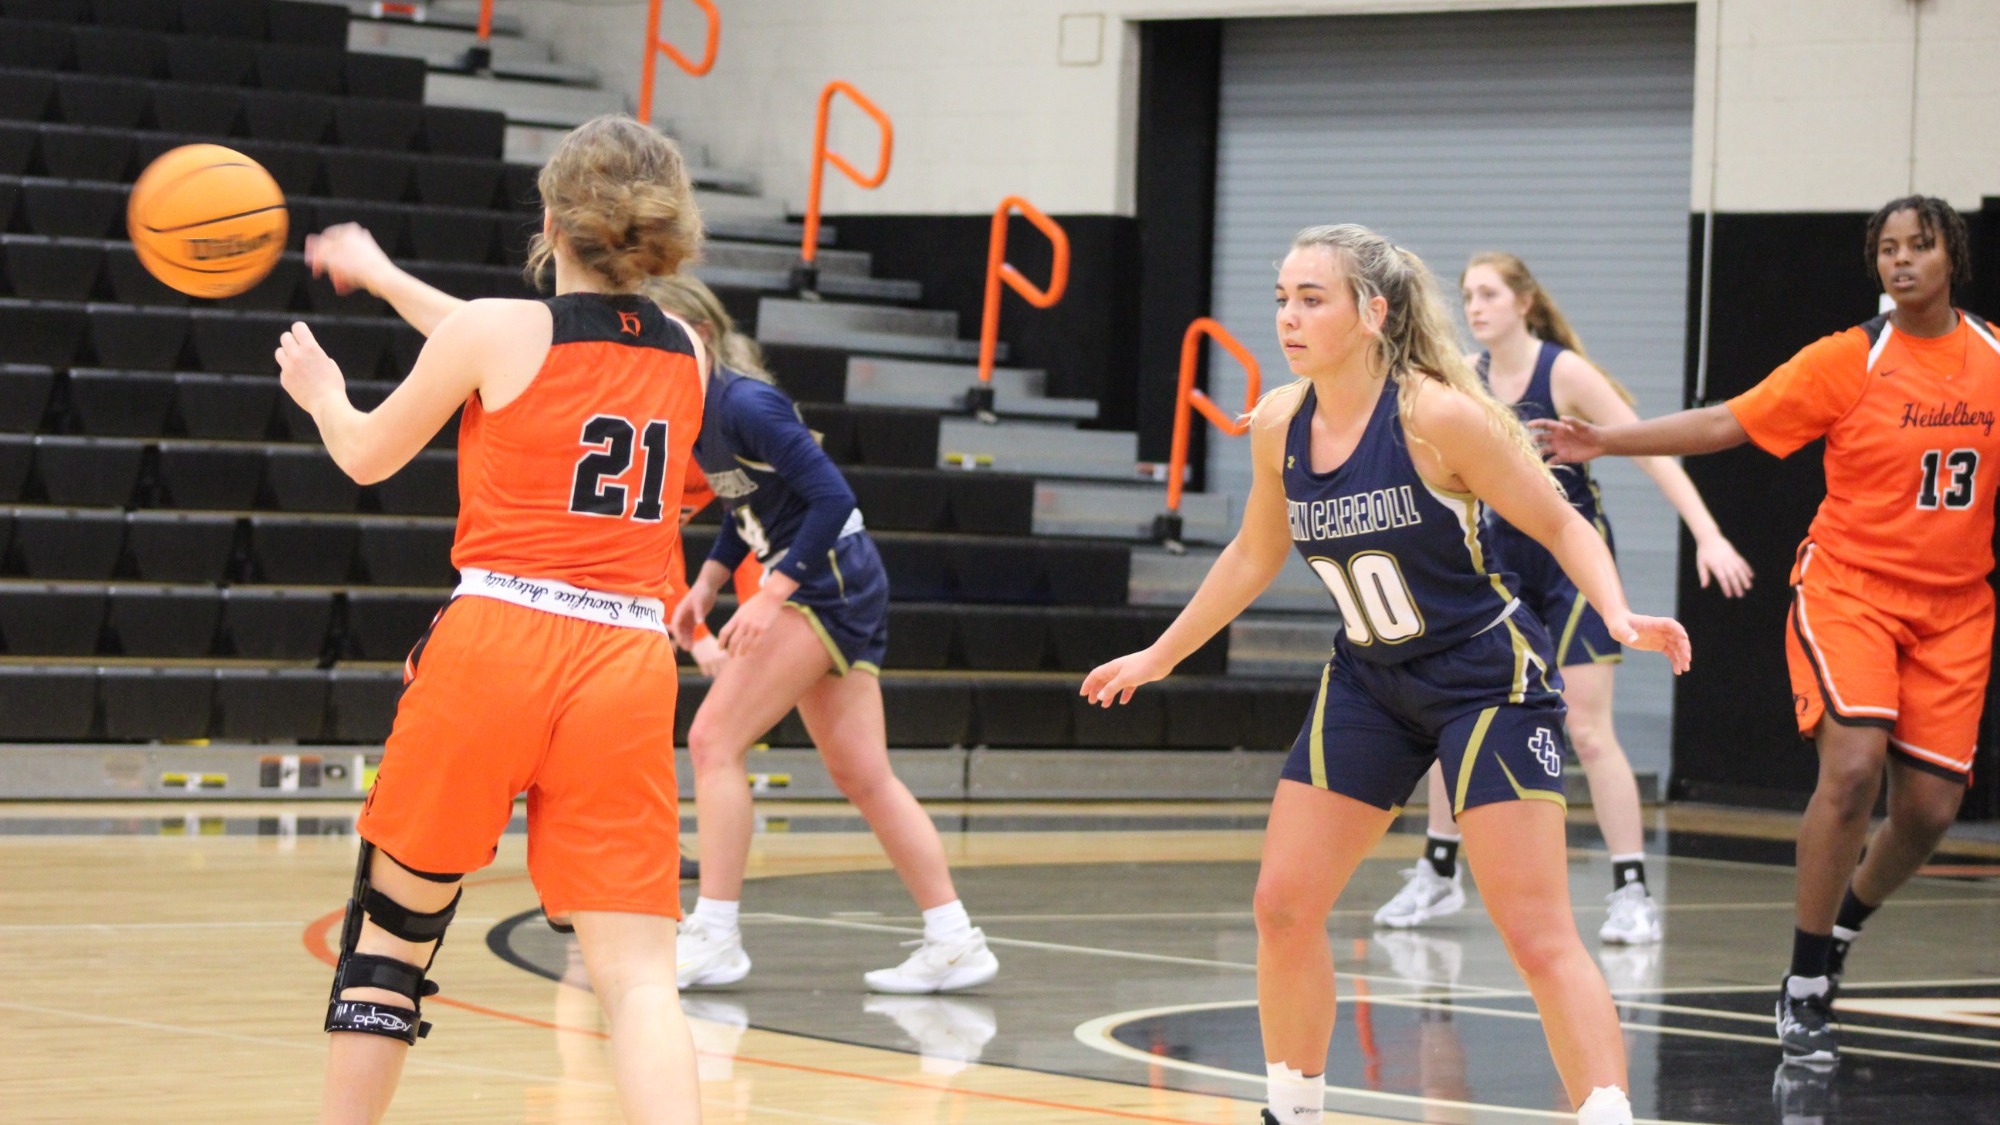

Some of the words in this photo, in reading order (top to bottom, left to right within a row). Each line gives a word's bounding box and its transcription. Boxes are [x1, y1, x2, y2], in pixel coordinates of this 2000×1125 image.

[1899, 401, 1995, 436] Heidelberg
[568, 413, 668, 523] 21
[1916, 448, 1980, 511] 13
[1311, 485, 1422, 540] CARROLL
[483, 571, 548, 602] Integrity
[554, 588, 622, 620] Sacrifice
[627, 597, 660, 625] Unity
